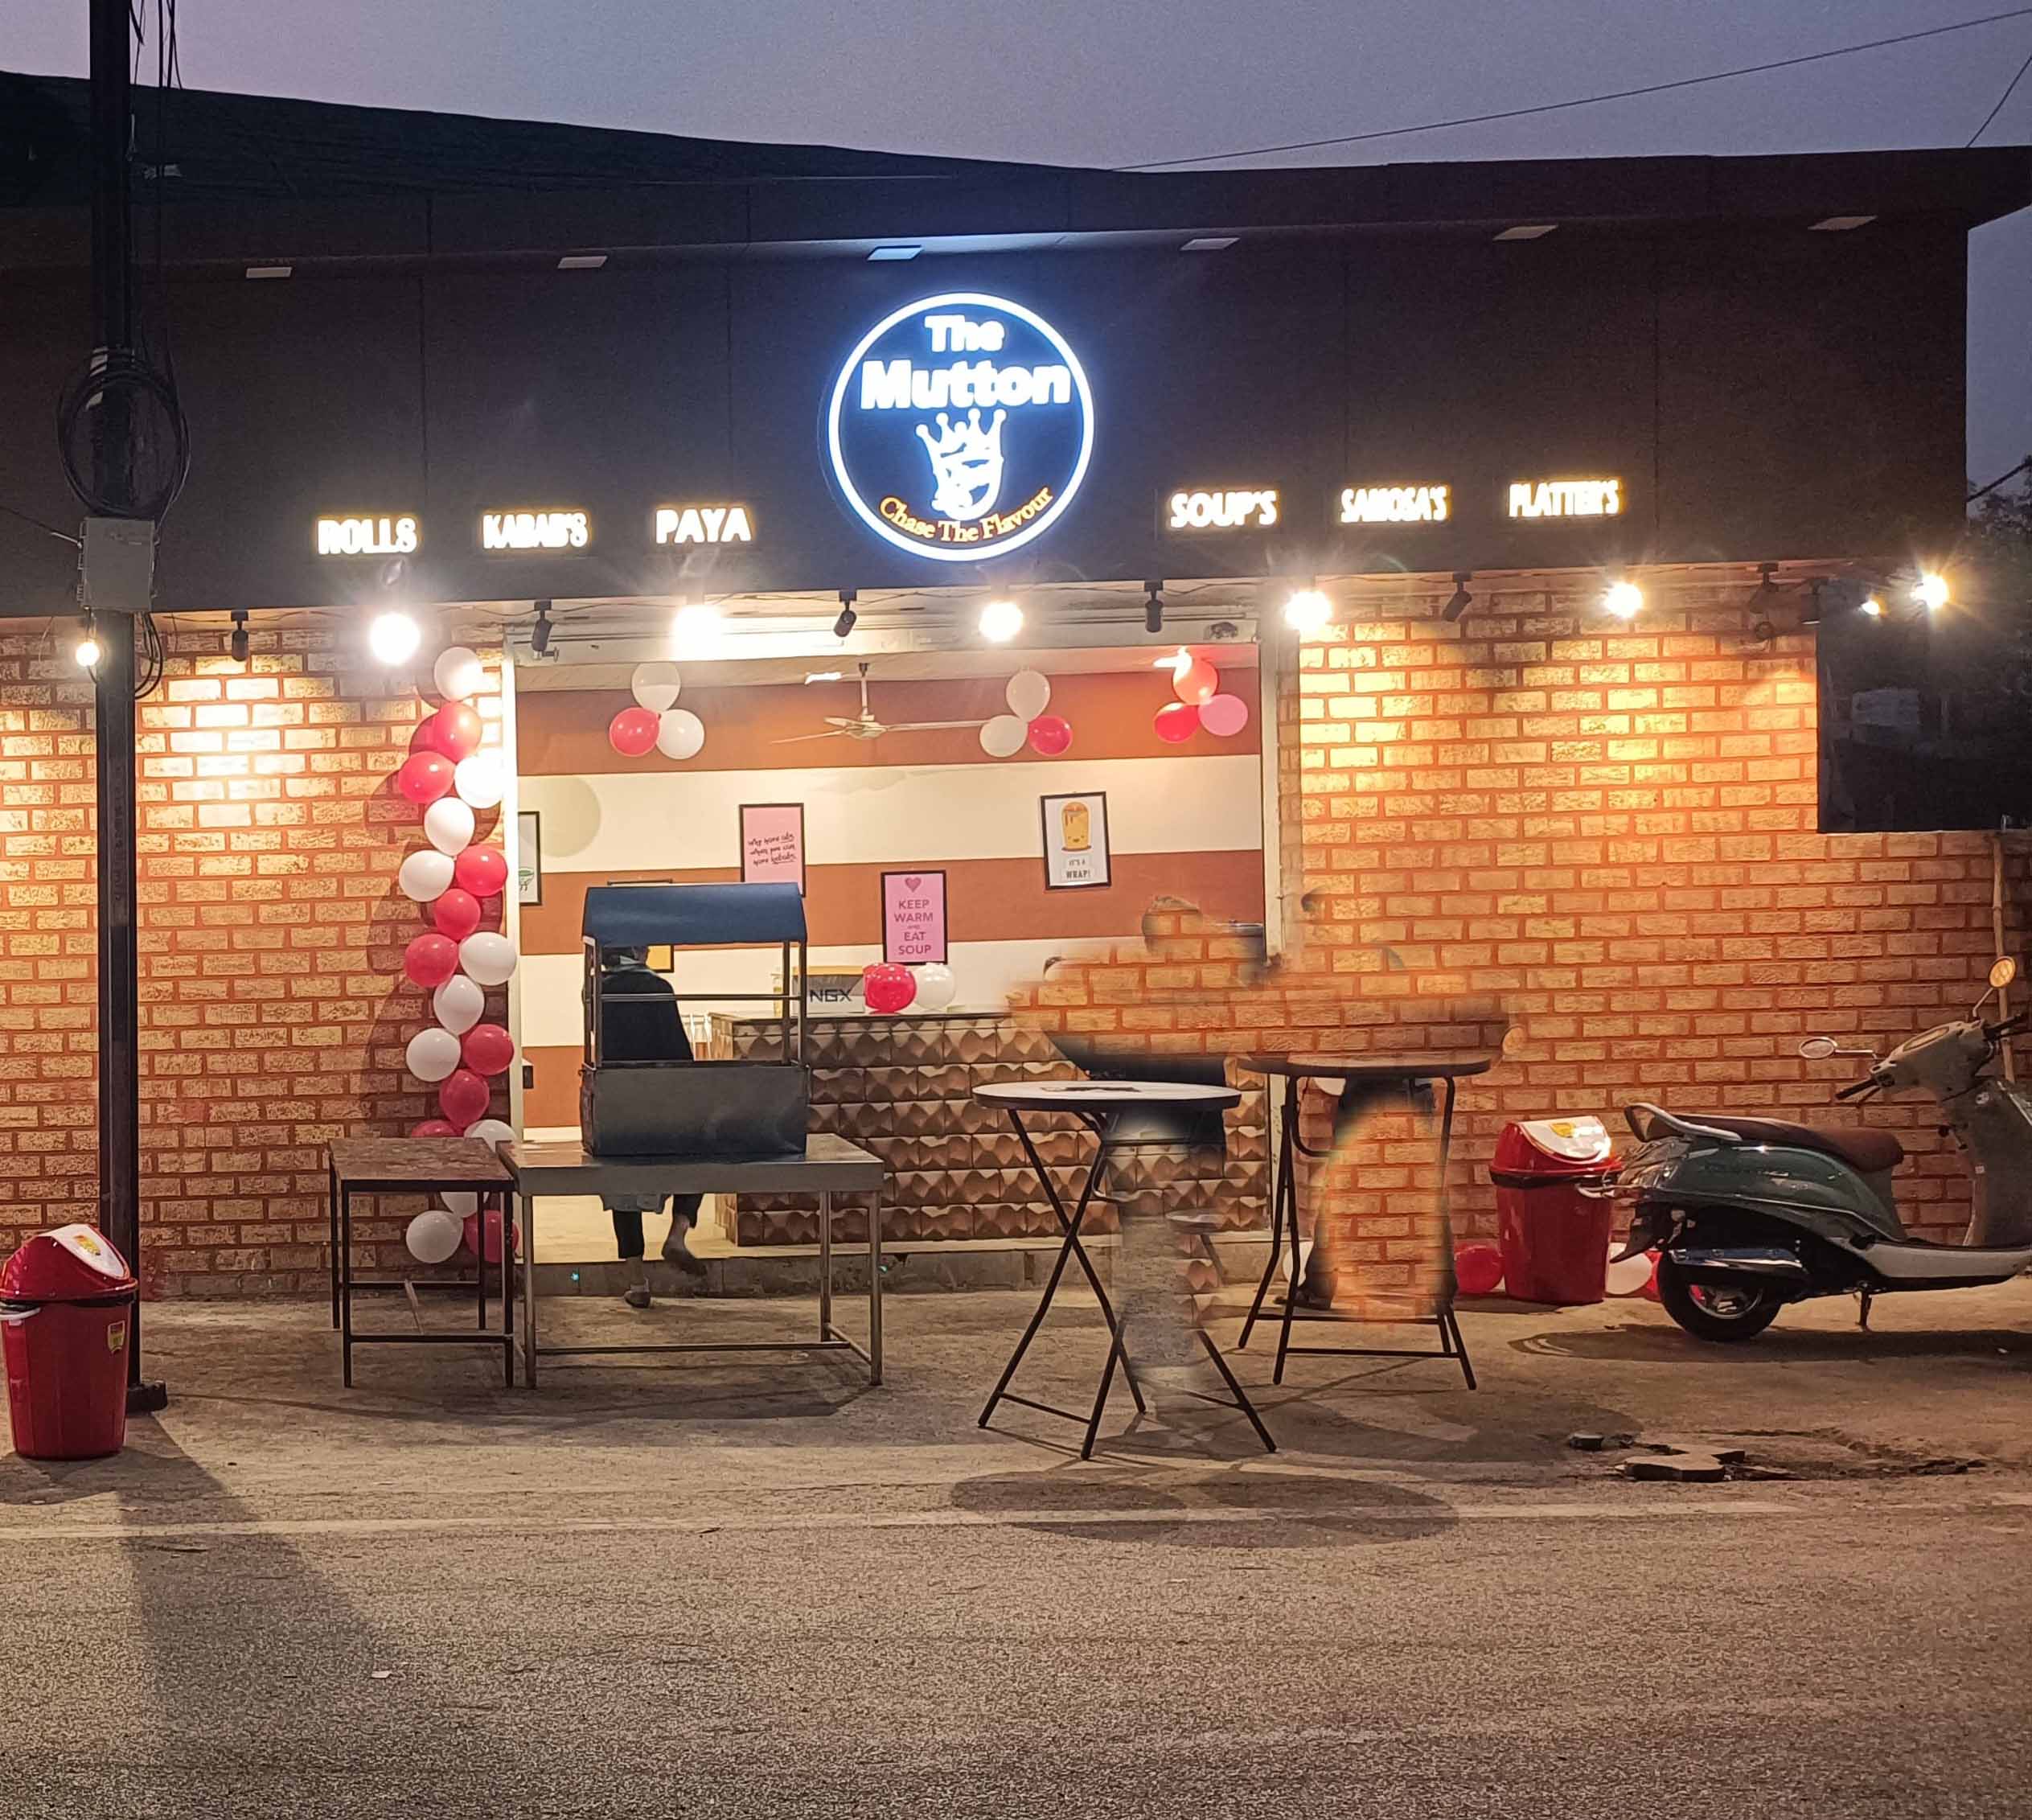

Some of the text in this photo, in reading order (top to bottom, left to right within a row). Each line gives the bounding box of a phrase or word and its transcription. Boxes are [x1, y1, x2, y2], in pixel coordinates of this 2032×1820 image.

[924, 314, 1005, 352] The
[860, 359, 1072, 410] Mutton
[879, 487, 1054, 542] Chase The Flavour
[1170, 489, 1278, 528] SOUP'S
[1340, 485, 1447, 523] SAMOSA'S
[1509, 479, 1619, 517] PLATTER'S
[317, 517, 418, 555] ROLLS
[655, 507, 753, 544] PAYA
[893, 912, 934, 923] WARM
[898, 899, 930, 910] KEEP
[898, 944, 932, 955] SOUP
[904, 931, 927, 942] EAT
